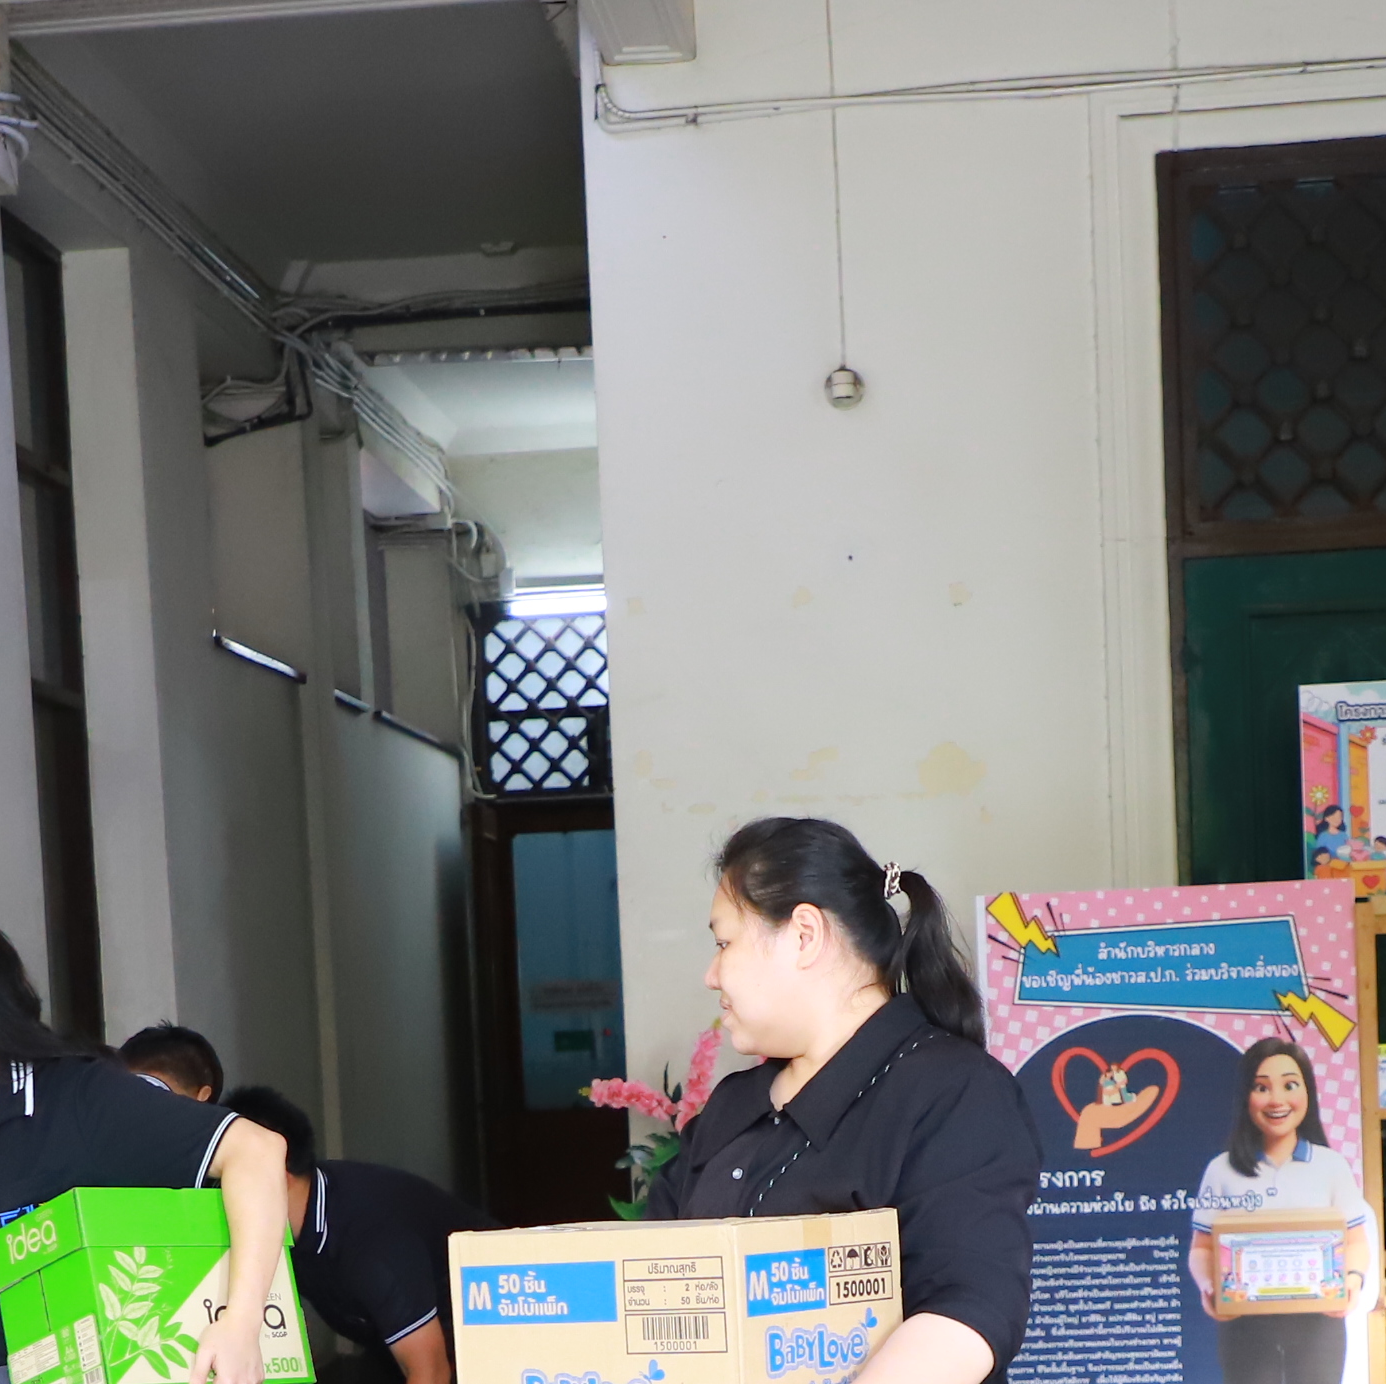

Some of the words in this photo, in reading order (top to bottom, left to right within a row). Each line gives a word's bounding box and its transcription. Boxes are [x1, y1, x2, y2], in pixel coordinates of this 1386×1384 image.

[1097, 940, 1215, 961] สำนักบริหารกลาง
[1185, 956, 1299, 982] ร่วมบริจาคสิ่งของ
[1039, 1170, 1104, 1187] รงการ
[6, 1220, 57, 1265] idea
[648, 1262, 697, 1277] ปริมาณสุทธิ
[749, 1270, 769, 1301] M
[771, 1261, 788, 1282] 50
[791, 1257, 808, 1280] ชิ้น
[469, 1282, 491, 1311] M
[498, 1274, 520, 1294] 50
[524, 1271, 546, 1293] ชิ้น
[771, 1282, 825, 1306] จัมโบ้แพ็ก
[835, 1277, 886, 1299] 1500001
[497, 1296, 568, 1317] จัมโบ้แพ็ก
[681, 1296, 691, 1305] 50
[654, 1341, 698, 1352] 1500001
